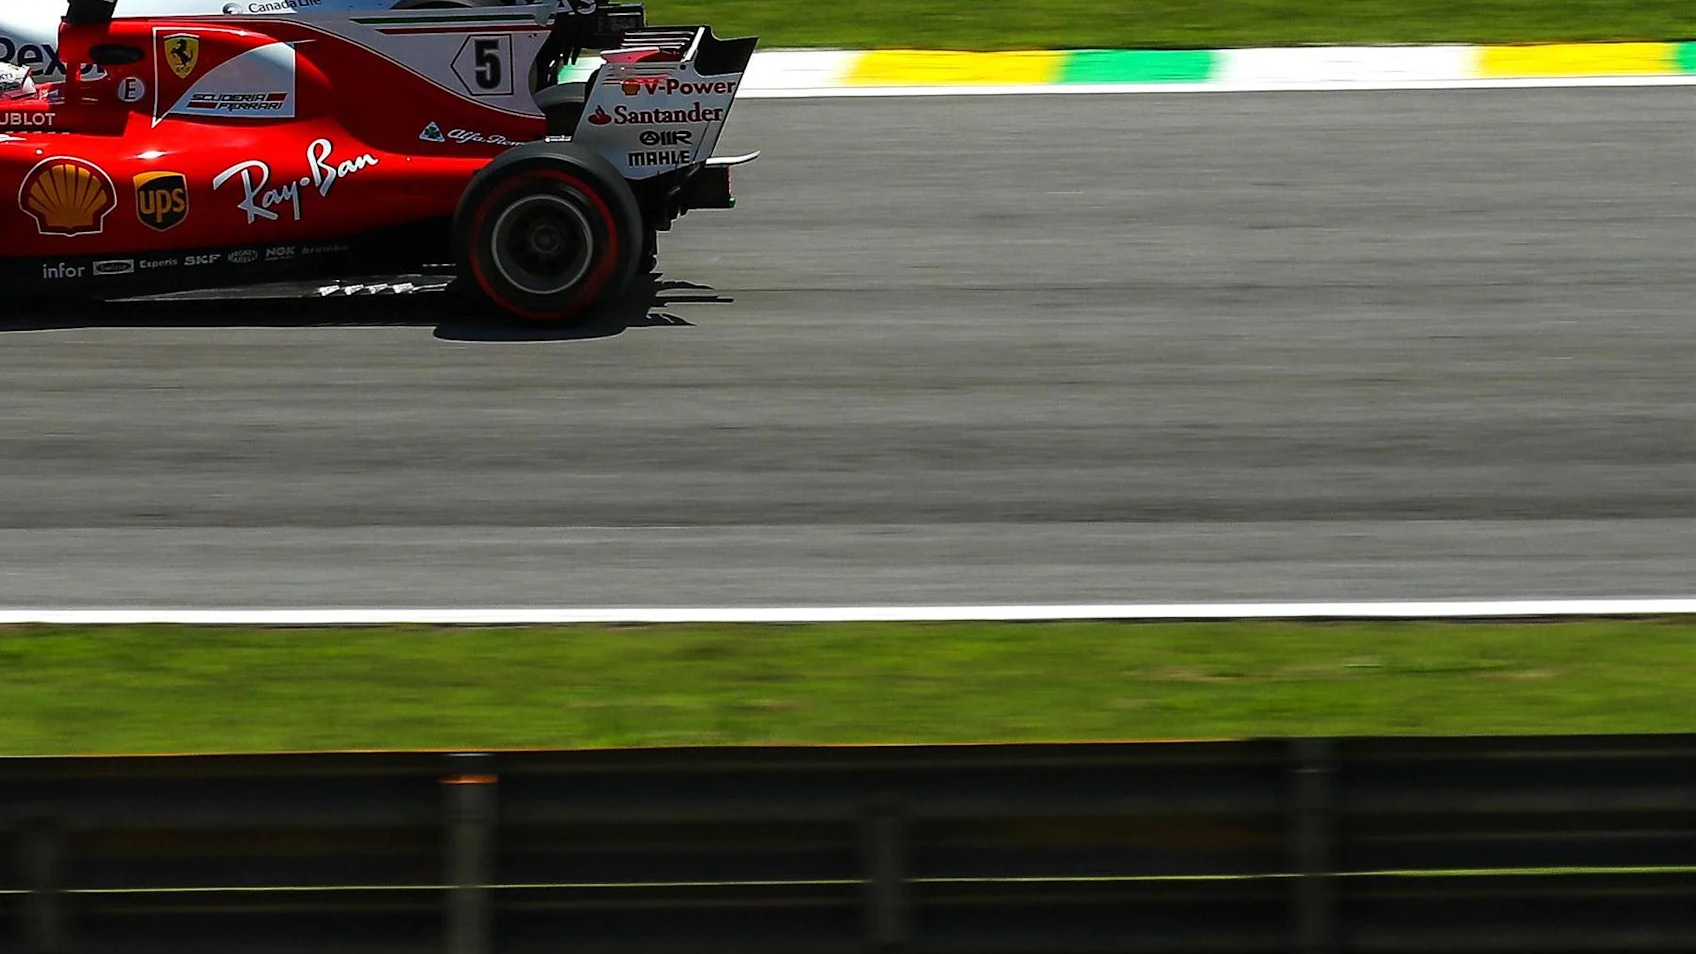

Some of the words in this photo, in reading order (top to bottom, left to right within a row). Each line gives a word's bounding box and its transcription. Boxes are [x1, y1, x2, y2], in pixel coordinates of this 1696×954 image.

[474, 39, 501, 90] 5
[642, 78, 736, 95] V-Power
[614, 102, 723, 125] Santander
[447, 128, 483, 143] Alfa
[628, 150, 691, 167] MAHLE
[138, 188, 186, 223] ups
[139, 257, 178, 269] Experis
[184, 254, 221, 266] SKF
[43, 262, 86, 279] infor
